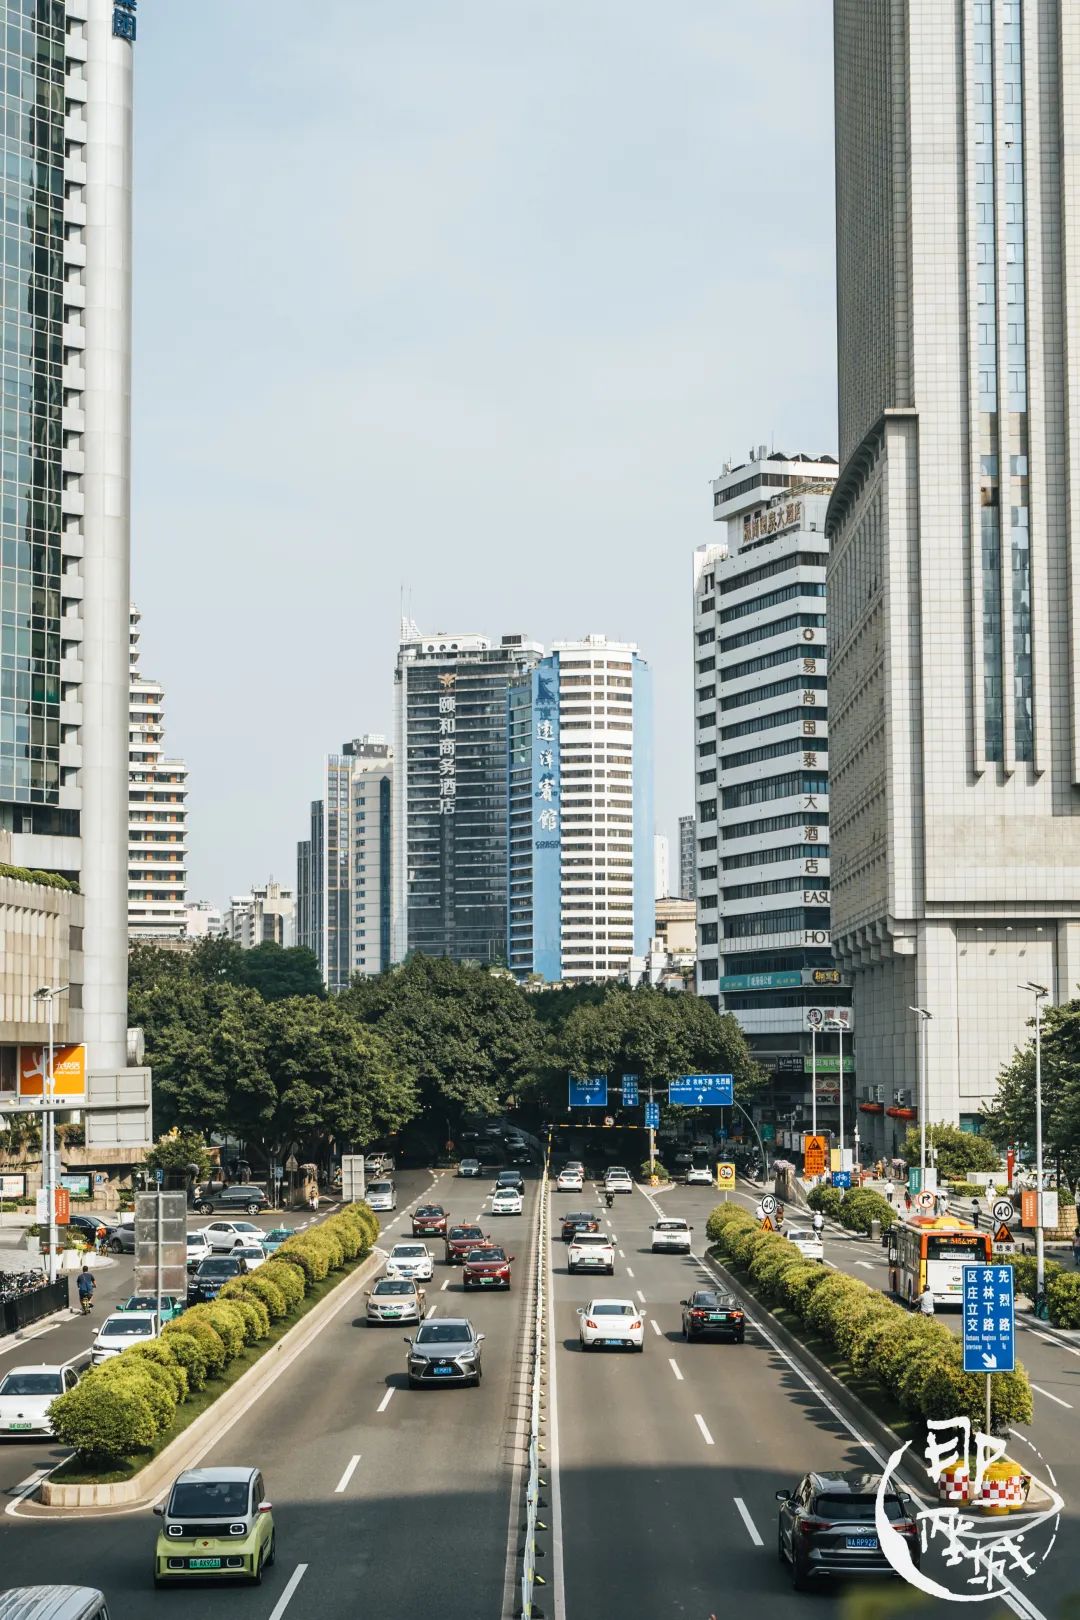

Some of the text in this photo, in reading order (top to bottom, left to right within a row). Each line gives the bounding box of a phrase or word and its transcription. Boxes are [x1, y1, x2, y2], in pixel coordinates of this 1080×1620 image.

[438, 697, 456, 815] 颐和商务酒店
[802, 659, 819, 874] 易尚国泰大酒店
[763, 1200, 773, 1210] 40
[996, 1206, 1010, 1217] 40
[967, 1270, 979, 1332] 区庄立交
[983, 1270, 994, 1332] 农林下路
[998, 1269, 1011, 1332] 先烈路
